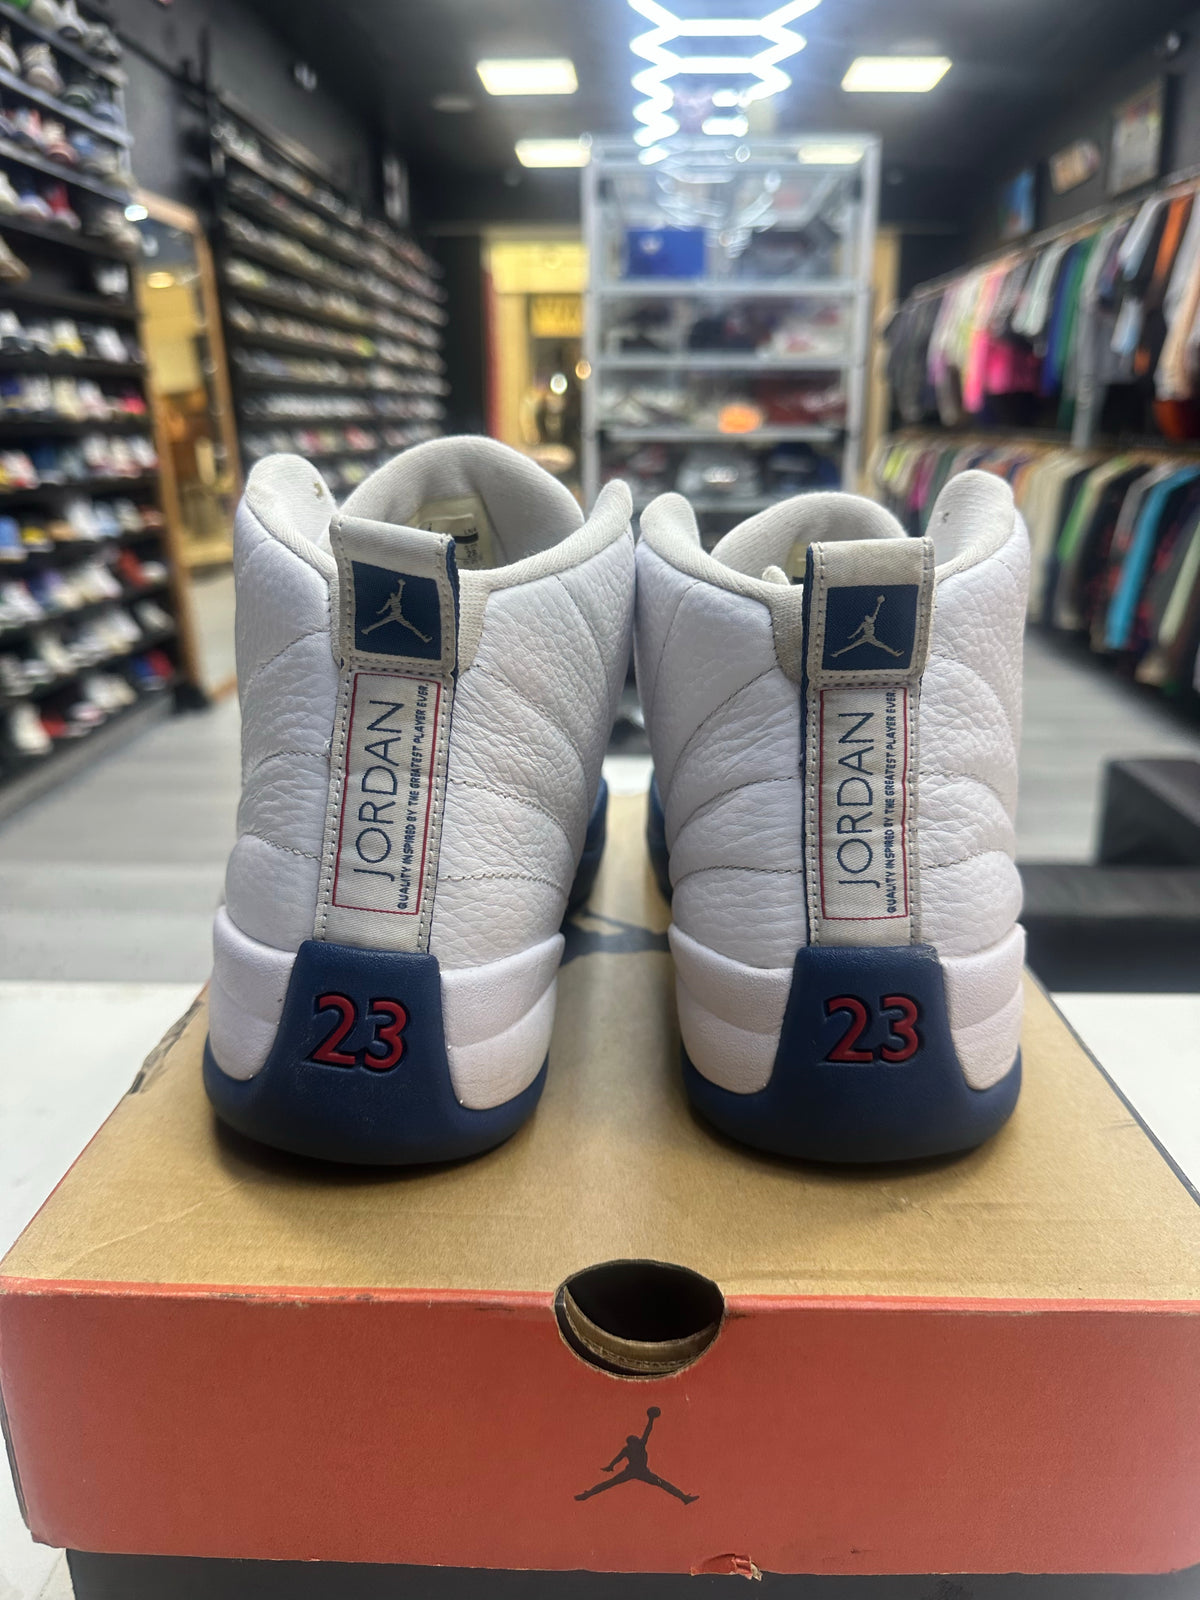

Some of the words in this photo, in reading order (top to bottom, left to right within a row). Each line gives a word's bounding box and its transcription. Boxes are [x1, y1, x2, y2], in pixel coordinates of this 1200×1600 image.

[416, 683, 429, 708] EVER.
[413, 709, 426, 744] PLAYER
[885, 715, 896, 750] PLAYER
[409, 745, 423, 789] GREATEST
[884, 752, 897, 796] GREATEST
[353, 700, 405, 882] JORDAN
[408, 790, 420, 806] THE
[837, 712, 881, 889] JORDAN
[884, 798, 895, 814] THE
[406, 808, 417, 822] BY
[883, 817, 894, 827] BY
[402, 824, 416, 865] INSPIRED
[883, 829, 896, 869] INSPIRED
[397, 866, 411, 910] QUALITY
[885, 871, 897, 914] QUALITY
[309, 992, 409, 1071] 23
[824, 994, 921, 1063] 23
